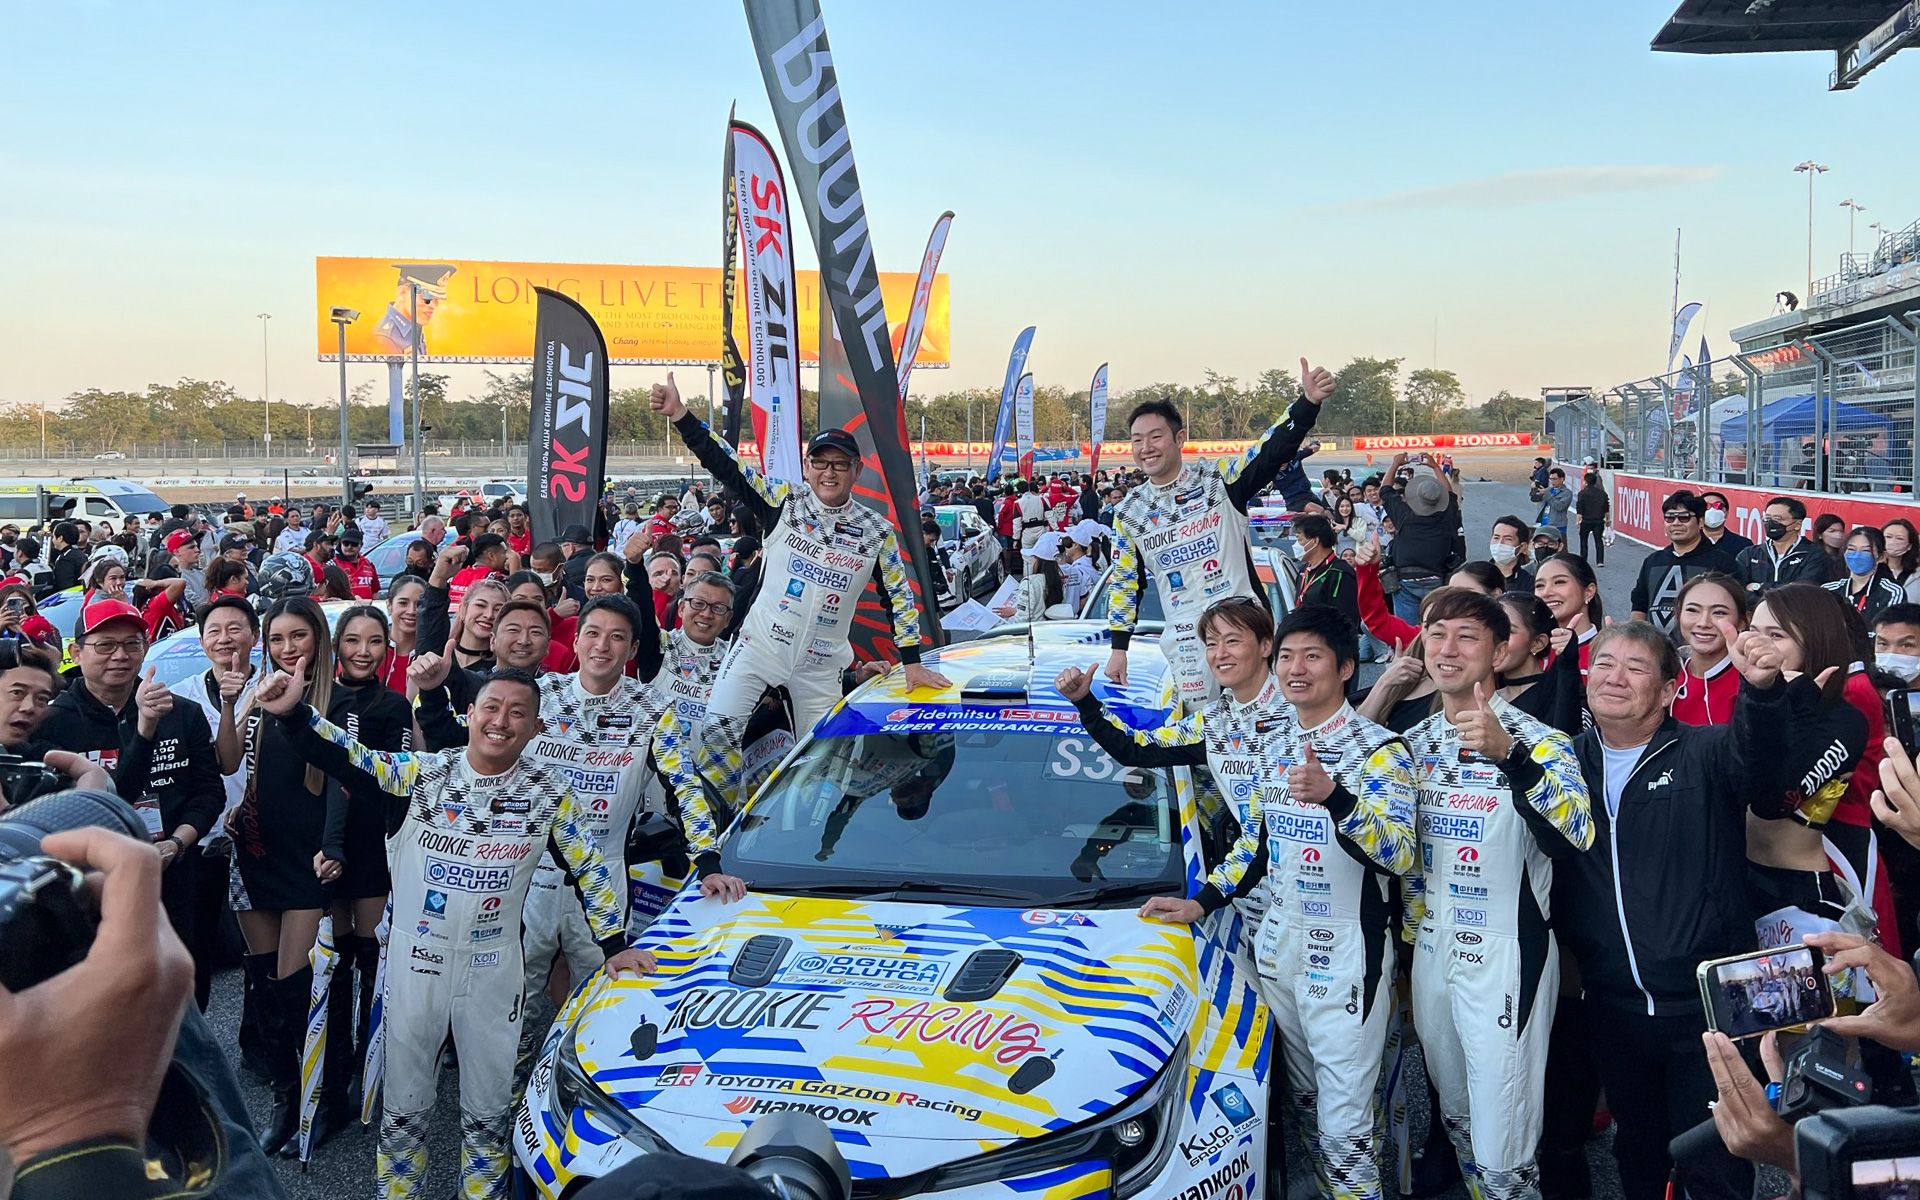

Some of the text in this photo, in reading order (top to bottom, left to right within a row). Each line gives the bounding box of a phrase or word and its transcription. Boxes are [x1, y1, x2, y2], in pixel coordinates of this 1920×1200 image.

[739, 170, 748, 203] EVERY
[742, 207, 753, 237] DROP
[751, 172, 792, 386] SK ZIC
[474, 276, 677, 308] LONG LIVE
[751, 269, 761, 317] GENUINE
[605, 312, 622, 320] THE
[626, 312, 652, 320] MOST
[656, 313, 708, 321] PROFOUND
[601, 321, 621, 329] AND
[613, 336, 639, 346] Chang
[754, 319, 766, 388] TECHNOLOGY
[1197, 441, 1245, 454] HON
[1364, 436, 1435, 448] HONDA
[1453, 434, 1522, 446] HONDA
[951, 442, 993, 456] HON
[1618, 486, 1651, 531] TOYOTA
[1144, 512, 1221, 551] ROOKIE RACING
[785, 533, 823, 560] ROOKIE
[824, 552, 864, 572] RACING
[1171, 537, 1214, 558] OGURA
[1173, 545, 1217, 565] CLUTCH
[804, 571, 847, 589] CLUTCH
[805, 563, 848, 582] OGURA
[670, 680, 701, 698] ROOKIE
[584, 699, 607, 707] ROOKIE
[917, 708, 996, 720] idemitsu
[880, 723, 1090, 735] SUPER ENDURANCE 202
[159, 738, 179, 746] OTA
[535, 741, 634, 766] ROOKIE RACING
[149, 758, 189, 774] ailand
[1220, 760, 1256, 775] ROOKIE
[1801, 739, 1849, 797] ROOKIE
[474, 776, 502, 788] ROOKIE
[564, 769, 615, 783] OGURA
[572, 778, 614, 791] LUTCH
[1448, 793, 1499, 812] RACING
[1277, 815, 1323, 831] OGURA
[1433, 816, 1479, 829] OGURA
[1277, 827, 1324, 841] CLUTCH
[1432, 826, 1479, 838] CLUTCH
[418, 830, 532, 861] ROOKIE RACING
[449, 866, 511, 879] OGURA
[446, 876, 510, 889] CLUTCH
[1304, 903, 1328, 912] KOD
[1457, 909, 1483, 921] KOD
[1032, 911, 1049, 923] E
[1315, 931, 1331, 939] Arai
[1460, 934, 1479, 943] Arai
[1758, 919, 1794, 949] CING
[412, 946, 443, 960] KUO
[1308, 944, 1334, 952] BRIDE
[474, 953, 496, 963] KOD
[833, 956, 941, 973] OGURA
[1459, 952, 1484, 964] FOX
[826, 966, 938, 983] CLUTCH
[832, 978, 881, 988] Racing
[884, 982, 930, 993] Clutch
[661, 988, 1046, 1064] ROOKIE RACING
[539, 1057, 552, 1093] KUO
[655, 1071, 697, 1087] GR
[705, 1074, 983, 1122] TOYOTA GAZOO Racing
[1225, 1091, 1240, 1107] GT
[1242, 1116, 1262, 1130] CAPITAL
[1178, 1125, 1229, 1160] KUO
[1189, 1134, 1234, 1168] GROUP
